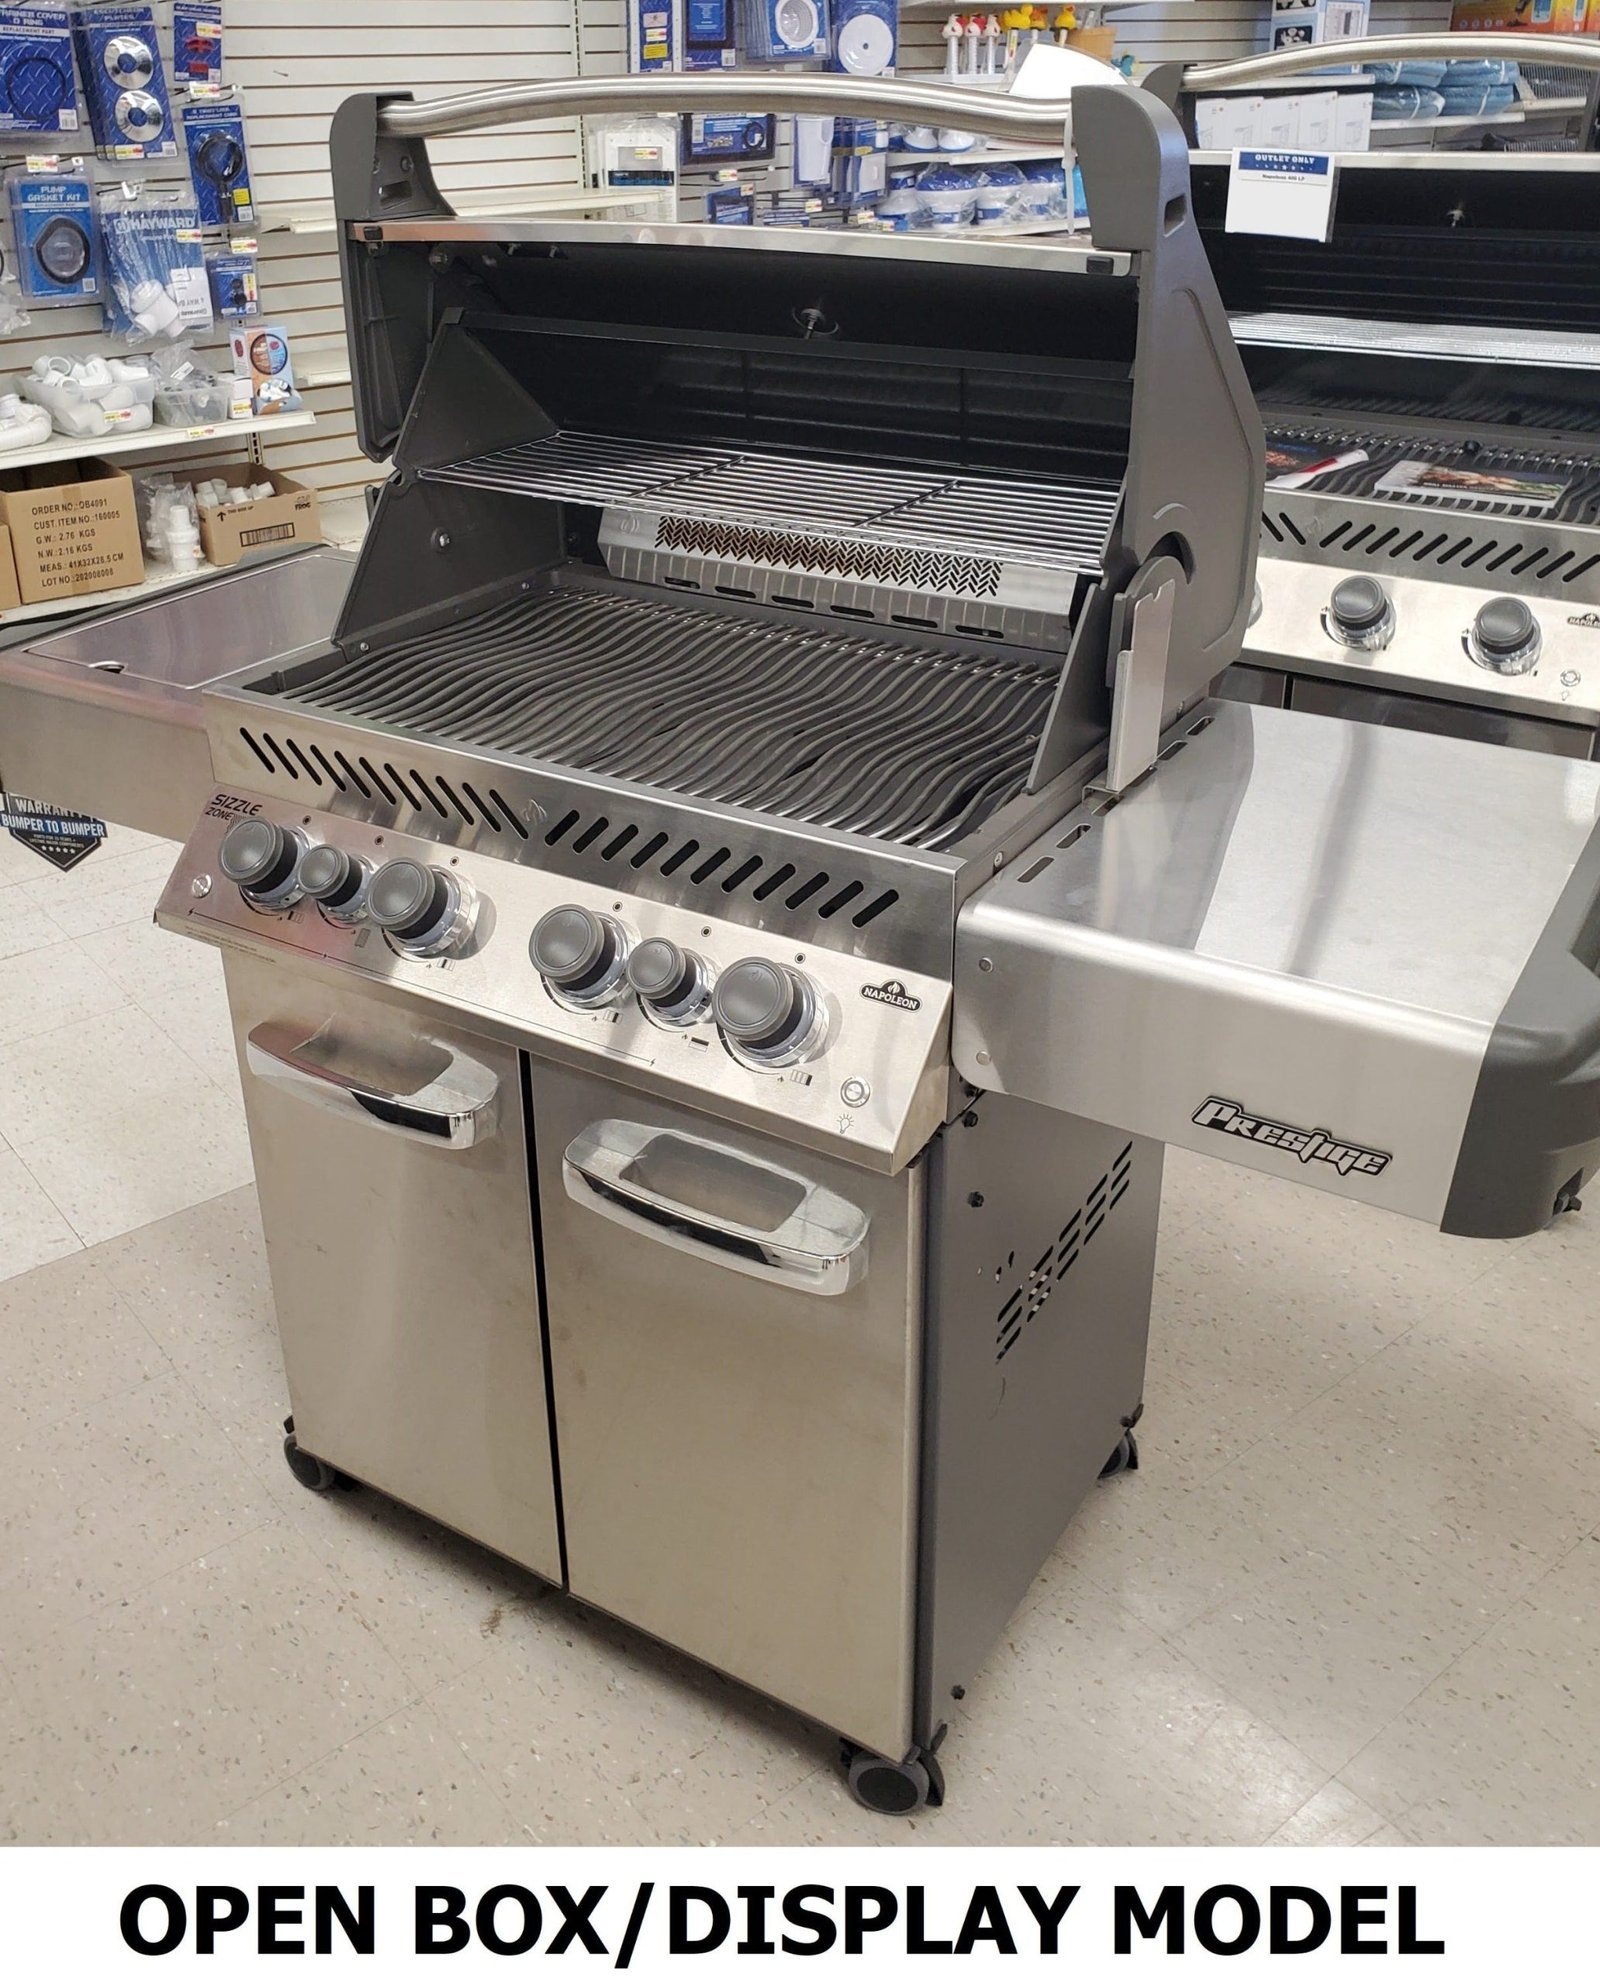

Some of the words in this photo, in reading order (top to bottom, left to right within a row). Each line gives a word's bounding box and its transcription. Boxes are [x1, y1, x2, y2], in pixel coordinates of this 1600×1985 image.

[1255, 154, 1291, 162] OUTLET
[1292, 156, 1315, 164] ONLY
[129, 217, 196, 230] HAYWARD
[32, 504, 60, 516] ORDER
[295, 502, 312, 511] FROG
[58, 516, 77, 526] ITEM
[79, 529, 96, 538] KGS
[76, 543, 93, 553] KGS
[112, 552, 124, 561] CM
[42, 577, 57, 587] LOT
[211, 794, 263, 816] SIZZLE
[205, 807, 234, 821] ZONE
[1, 813, 45, 832] BUMPER
[45, 820, 60, 833] TO
[60, 821, 105, 837] BUMPER
[863, 986, 919, 1010] NAPOLEON
